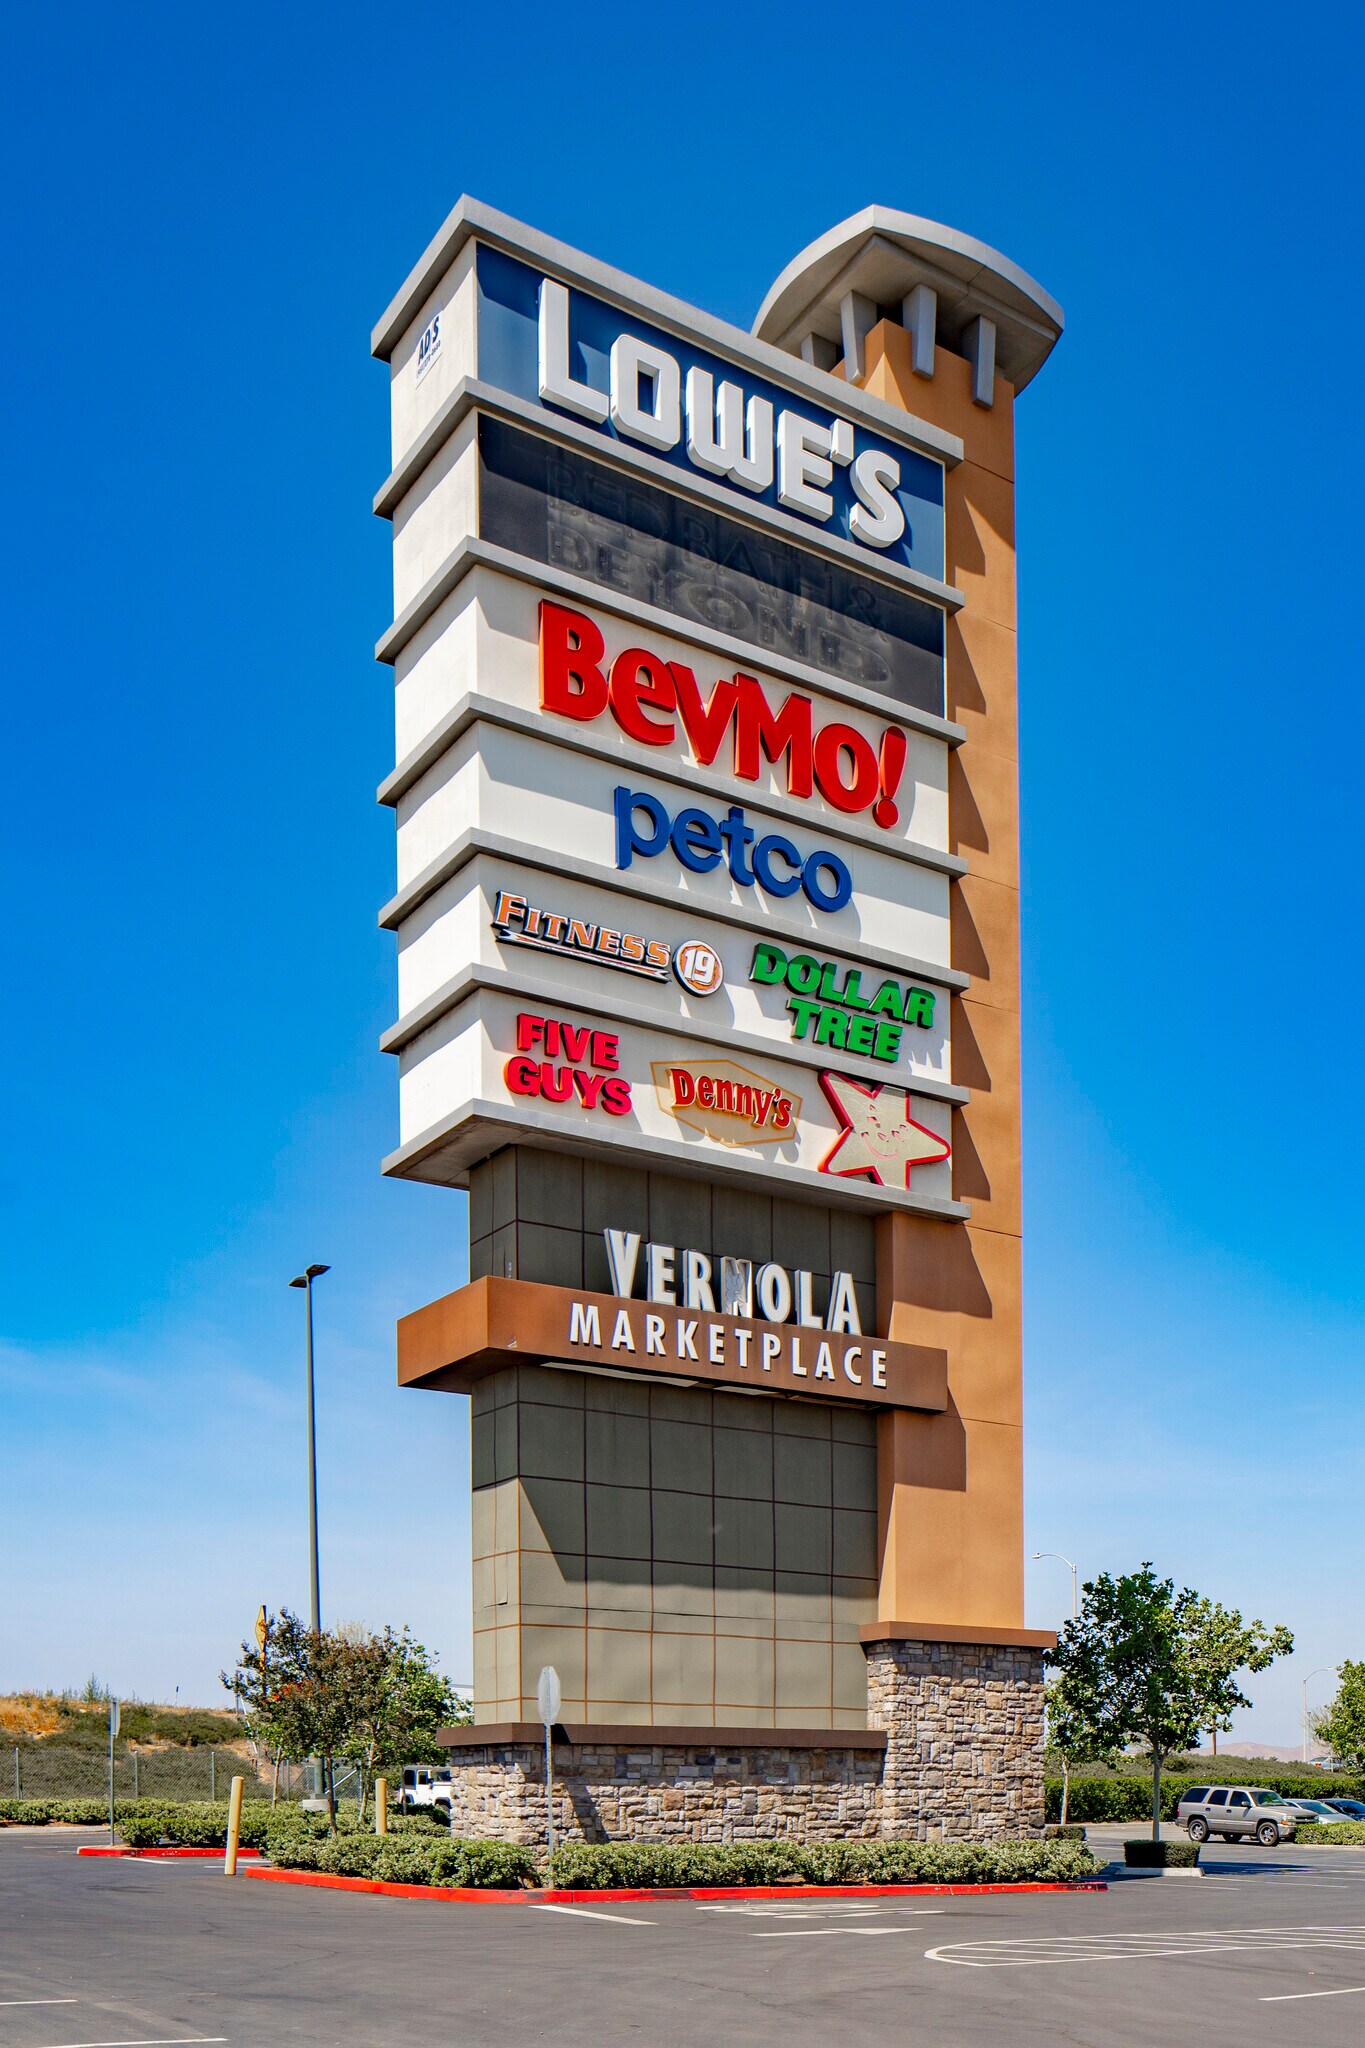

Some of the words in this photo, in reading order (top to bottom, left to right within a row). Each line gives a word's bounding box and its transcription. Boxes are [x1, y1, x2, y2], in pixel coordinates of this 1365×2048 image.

[538, 277, 905, 548] LOWE'S
[613, 785, 853, 913] petco
[492, 890, 671, 969] FITNESS
[749, 943, 936, 1029] DOLLAR
[516, 1012, 620, 1071] FIVE
[786, 997, 903, 1062] TREE
[504, 1056, 633, 1116] GUYS
[666, 1067, 793, 1130] Denny's
[603, 1227, 863, 1336] VERNOLA
[569, 1302, 888, 1388] MARKETPLACE
